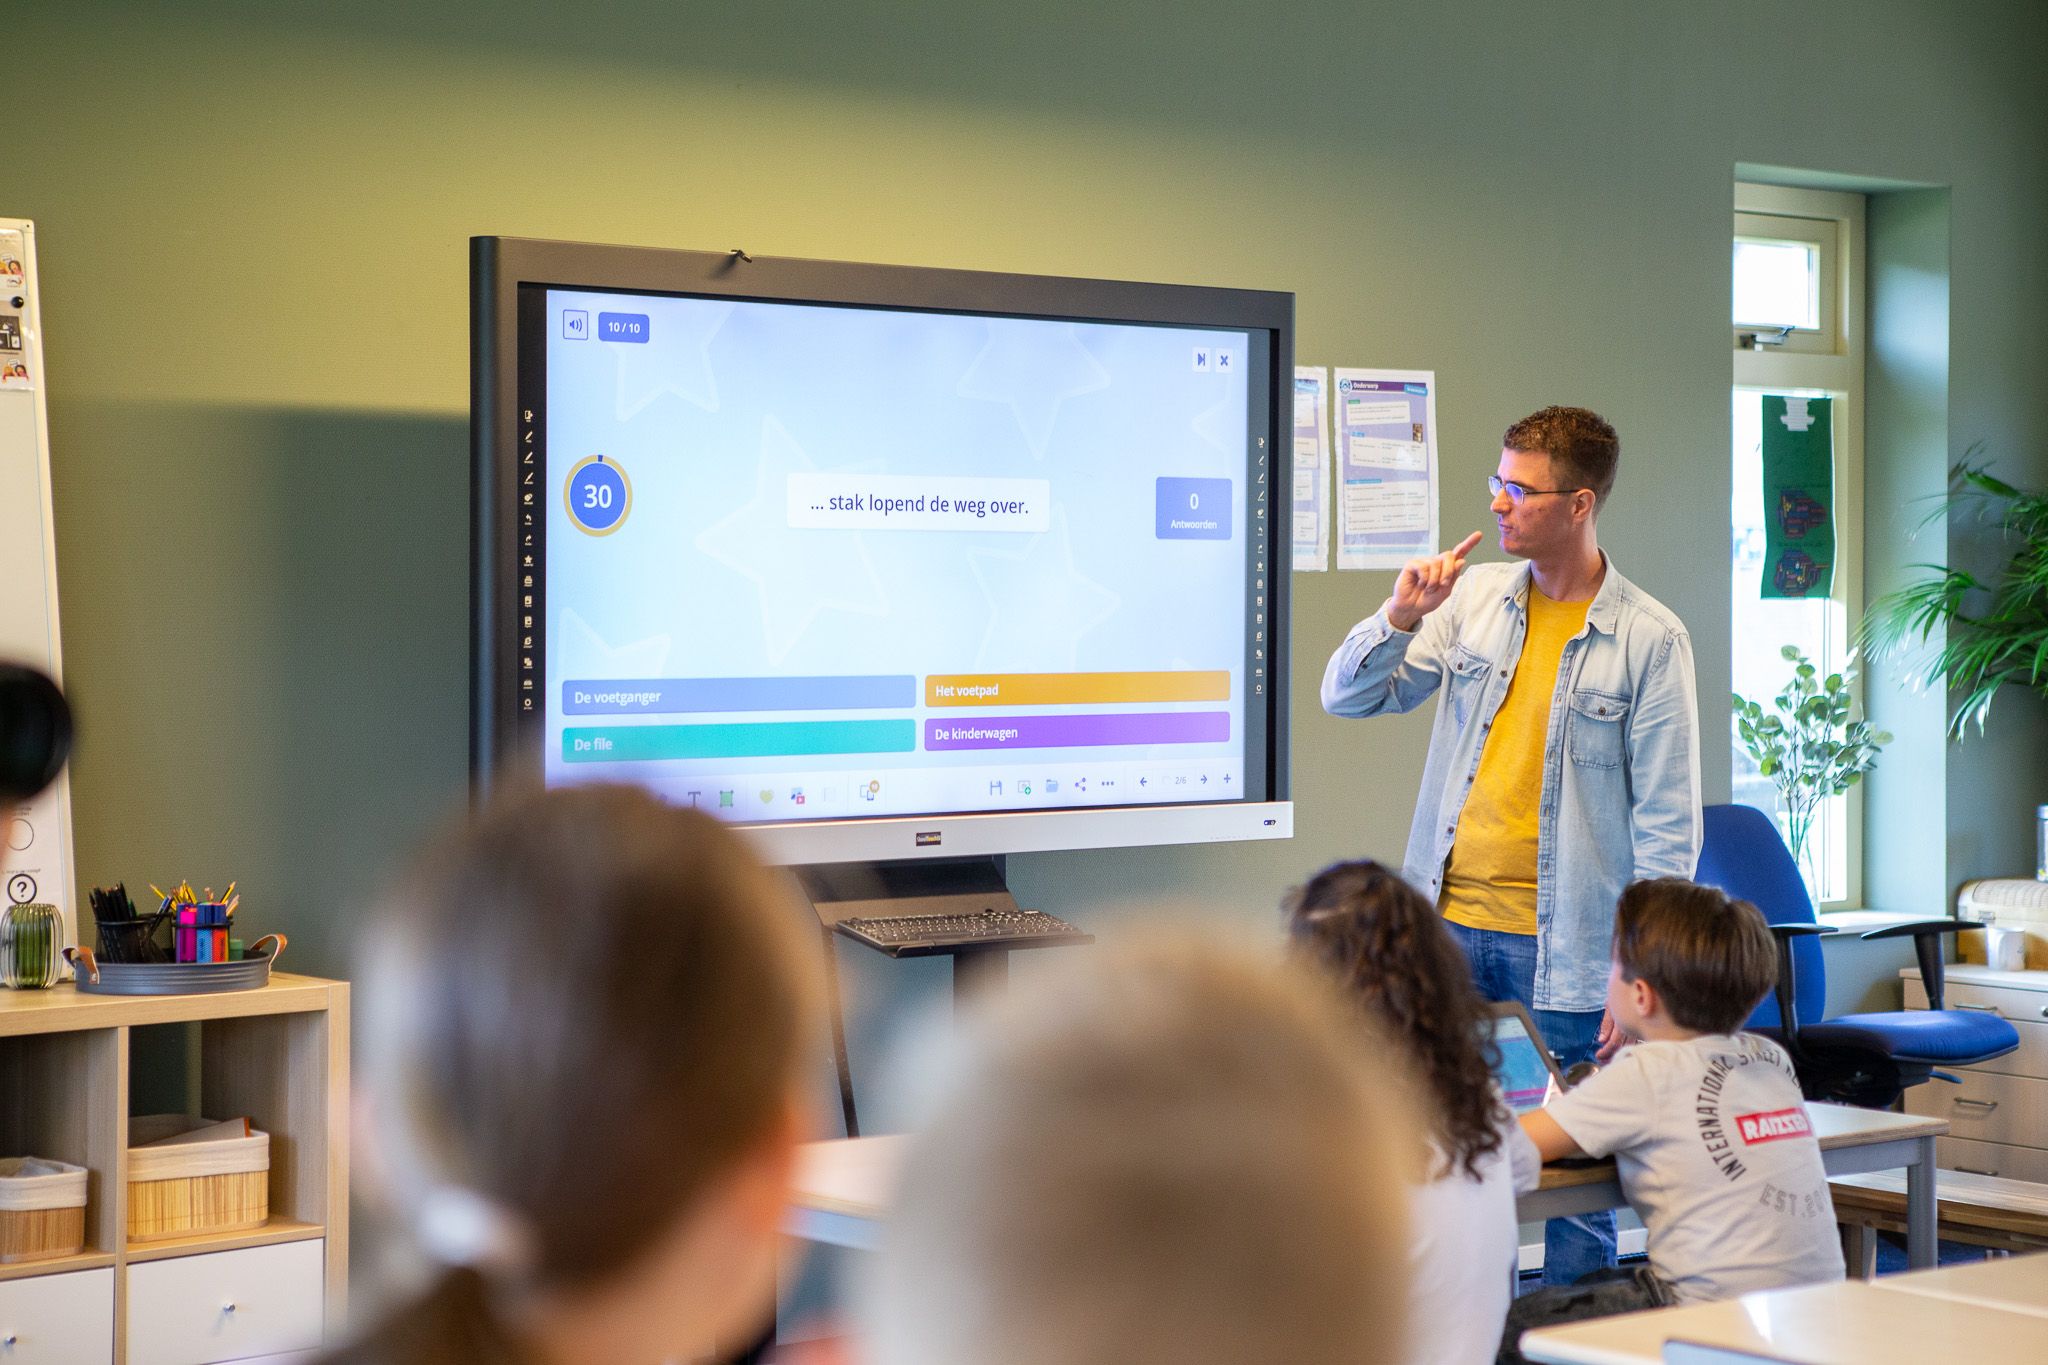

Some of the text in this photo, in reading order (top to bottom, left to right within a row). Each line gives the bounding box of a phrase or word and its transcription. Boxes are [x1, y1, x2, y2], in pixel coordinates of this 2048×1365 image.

[608, 321, 621, 334] 10
[628, 322, 641, 335] 10
[583, 484, 612, 508] 30
[1189, 493, 1199, 511] 0
[829, 493, 864, 512] stak
[869, 493, 926, 517] lopend
[930, 495, 950, 513] de
[954, 499, 986, 518] weg
[990, 499, 1029, 514] over.
[1170, 519, 1217, 530] Antwoorden
[574, 690, 662, 706] De voetganger
[935, 684, 999, 698] Het voetpad
[935, 727, 1018, 741] De kinderwagen
[574, 737, 613, 751] De file
[1696, 1056, 1747, 1182] INTERNATIONAL
